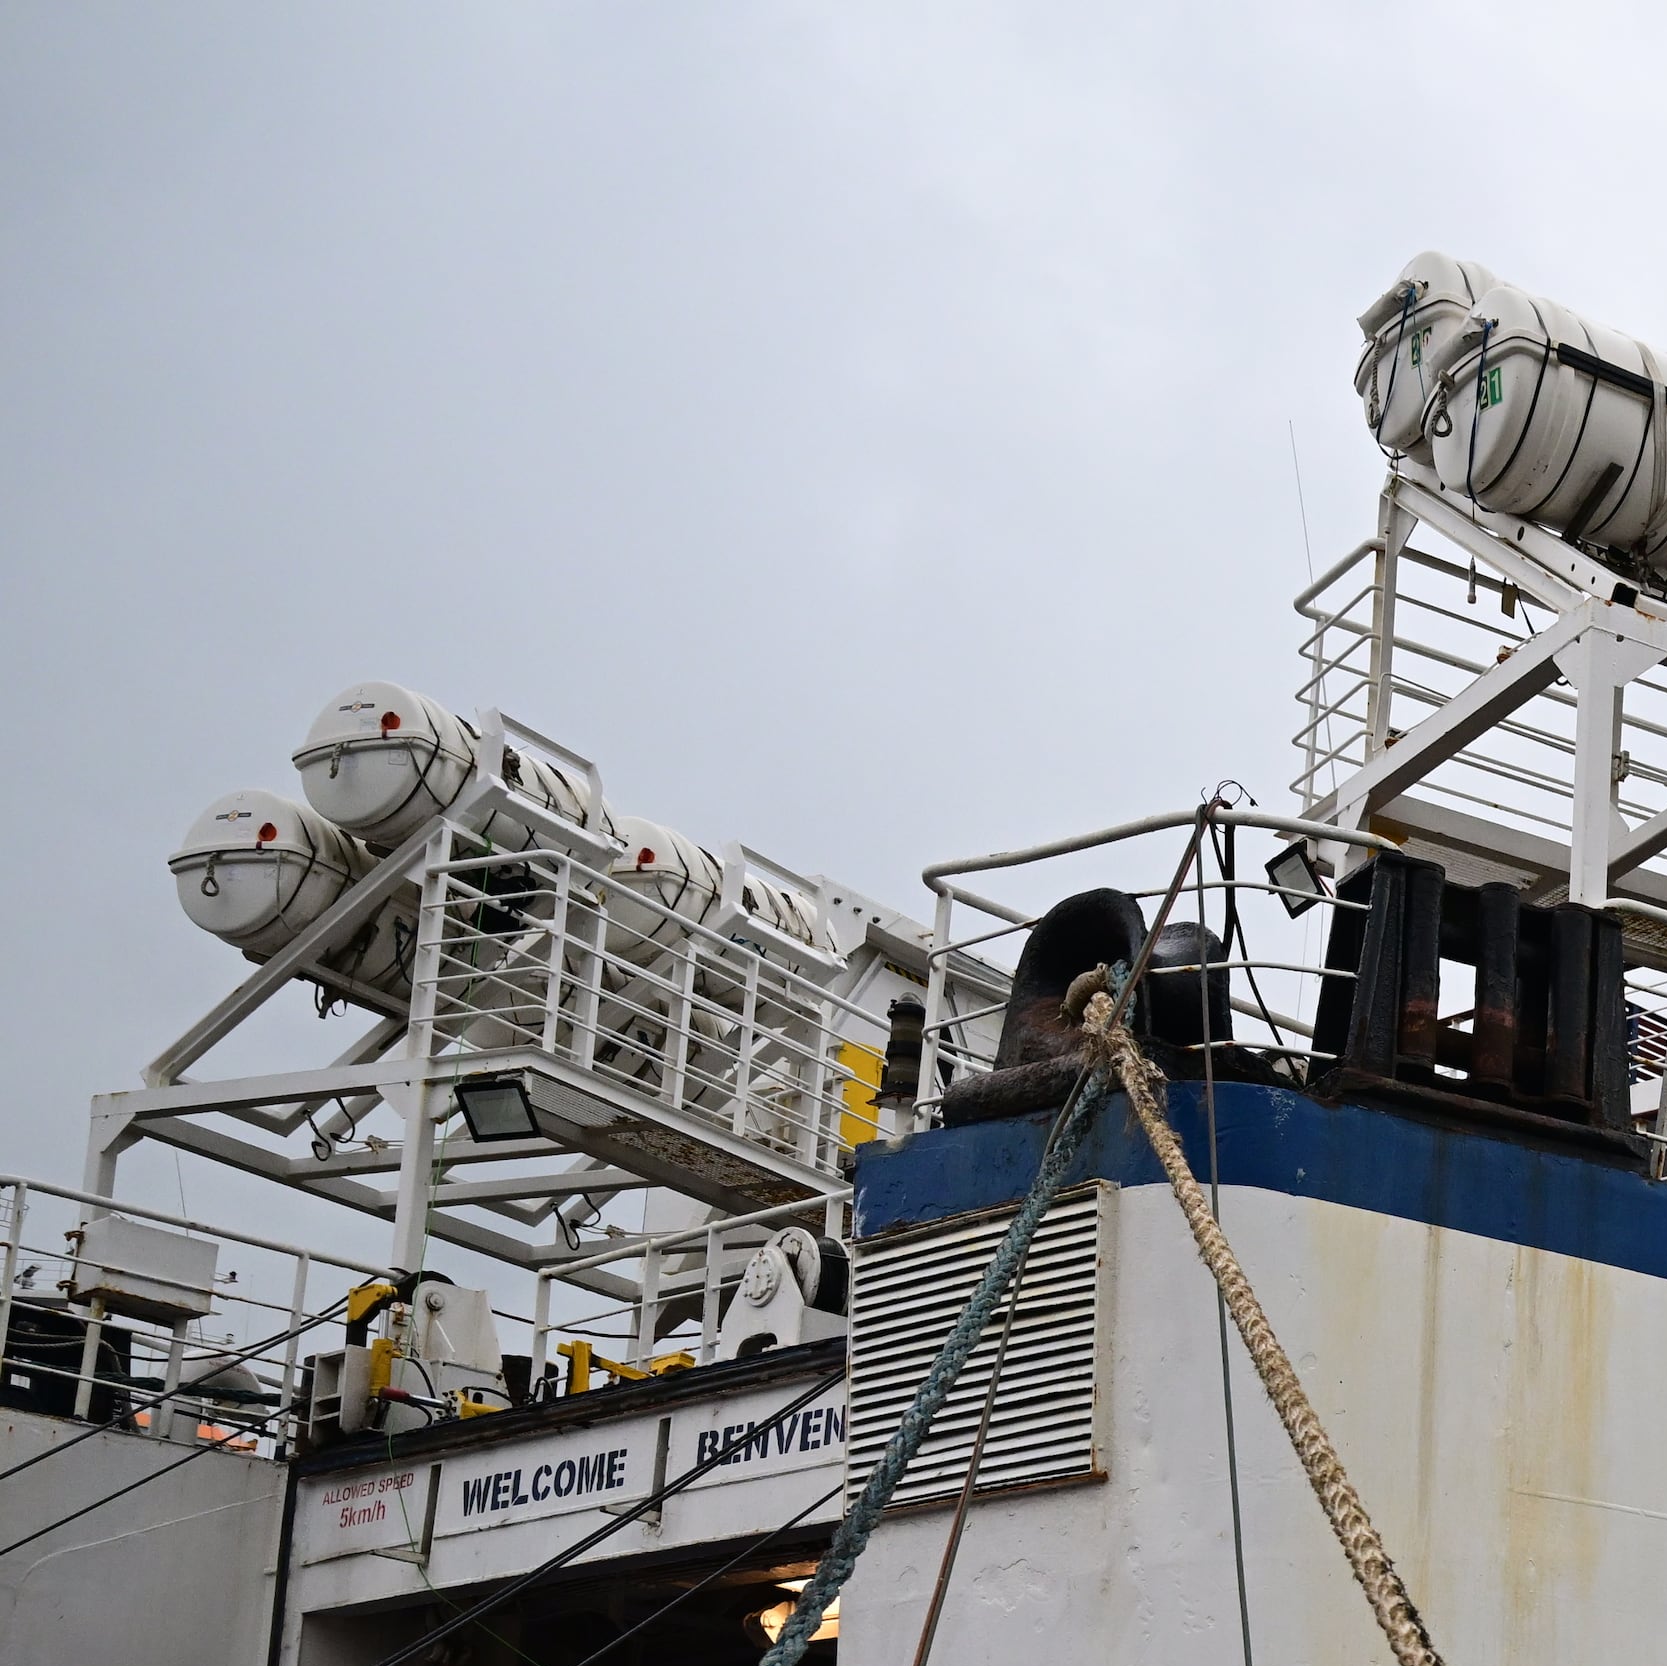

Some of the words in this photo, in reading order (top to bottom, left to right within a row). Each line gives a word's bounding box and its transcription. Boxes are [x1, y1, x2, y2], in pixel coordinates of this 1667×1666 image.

[1480, 369, 1501, 407] 21
[322, 1481, 375, 1506] ALLOWED
[378, 1472, 414, 1493] SPEED
[463, 1448, 627, 1517] WELCOME
[340, 1500, 386, 1529] 5km/h
